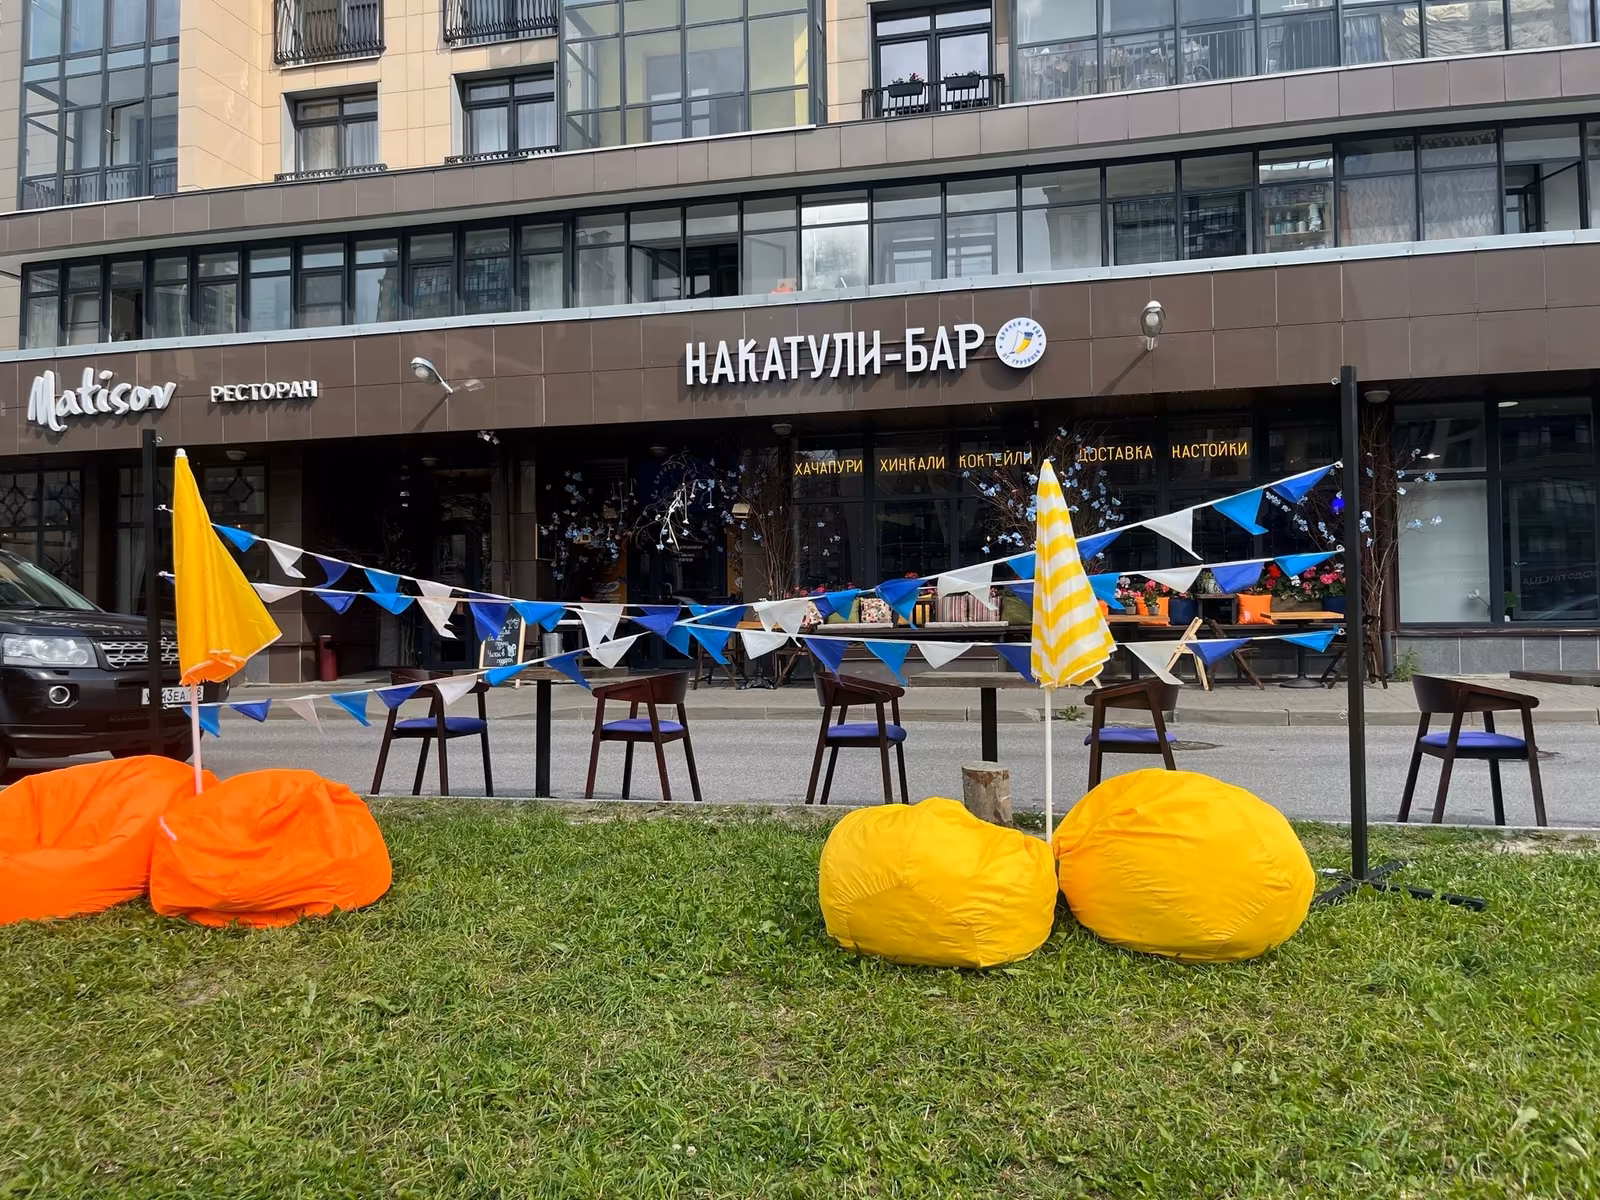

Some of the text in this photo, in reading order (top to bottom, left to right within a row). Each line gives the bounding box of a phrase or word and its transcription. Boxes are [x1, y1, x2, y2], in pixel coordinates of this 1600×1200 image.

[685, 323, 985, 386] НАКАТУЛИ-БАР
[27, 366, 177, 432] Matisov
[210, 380, 319, 403] РЕСТОРАН
[794, 459, 864, 476] ХАЧАПУРИ
[879, 455, 946, 472] ХИНКАЛИ
[1078, 445, 1154, 463] ДОСТАВКА
[1171, 441, 1249, 460] НАСТОЙКИ
